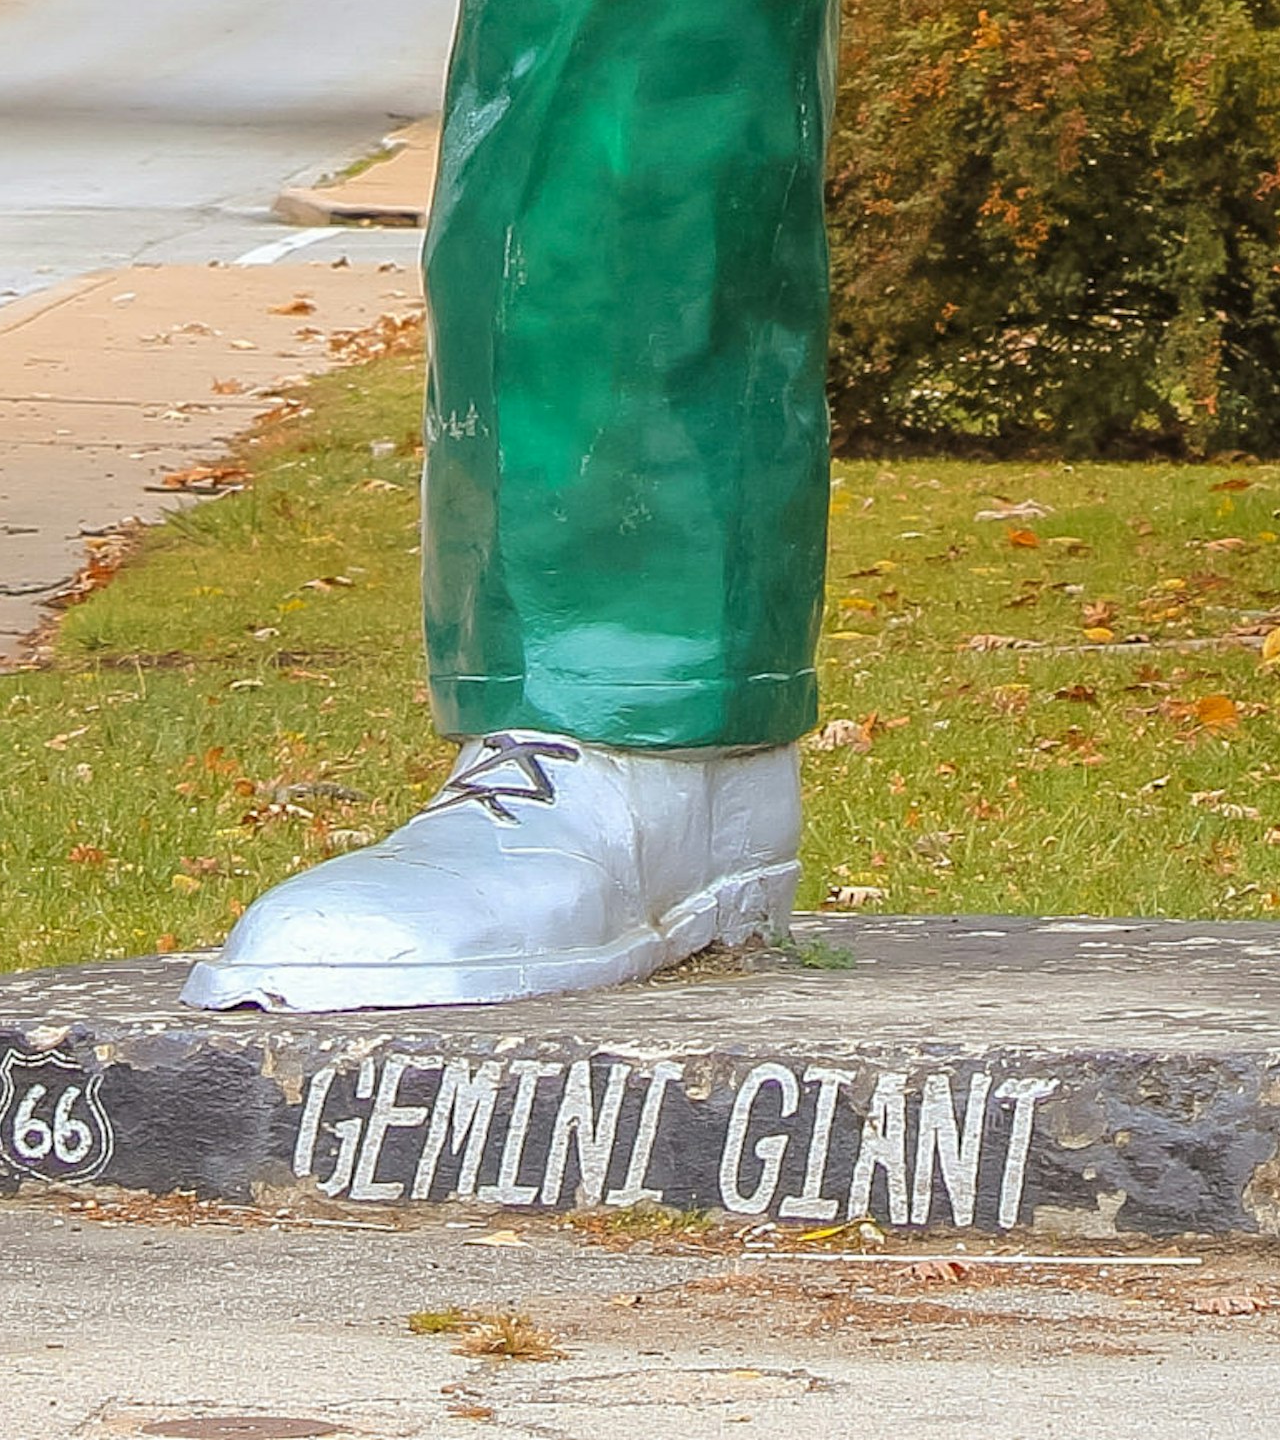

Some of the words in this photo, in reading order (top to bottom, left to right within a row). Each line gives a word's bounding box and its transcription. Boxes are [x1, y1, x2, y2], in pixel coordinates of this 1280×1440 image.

[13, 1083, 93, 1164] 66
[293, 1052, 686, 1207] GEMINI
[719, 1061, 1061, 1230] GIANT
